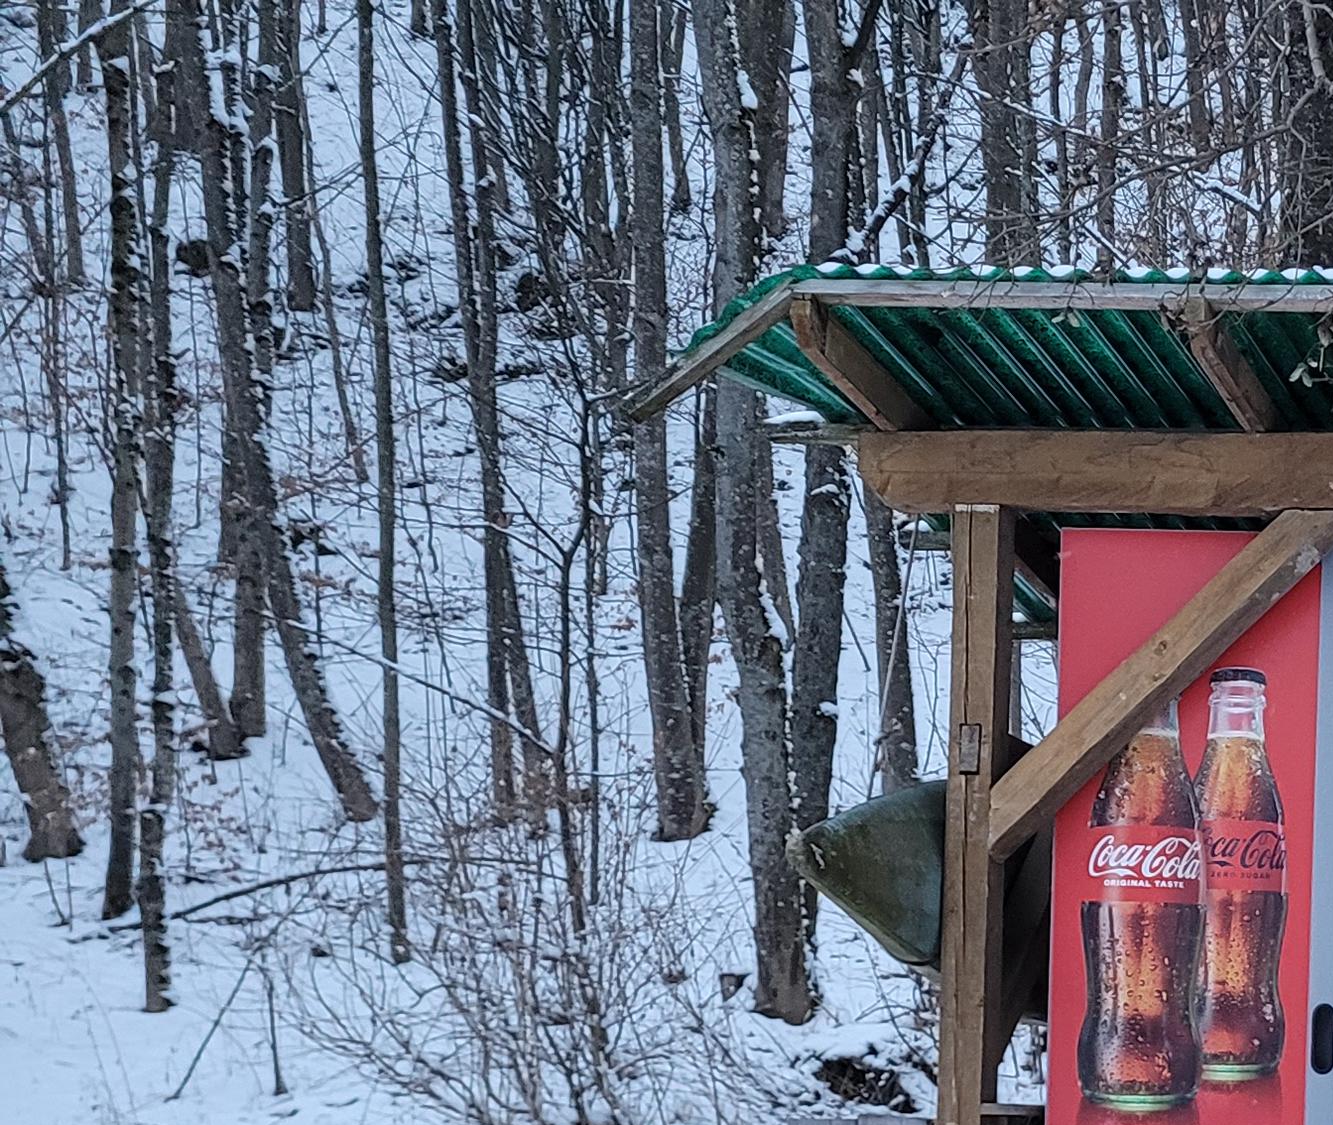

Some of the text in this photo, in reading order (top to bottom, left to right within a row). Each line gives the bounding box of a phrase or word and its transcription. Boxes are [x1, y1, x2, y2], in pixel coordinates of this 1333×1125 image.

[1088, 834, 1201, 880] Coca-Cola
[1103, 879, 1185, 889] ORIGINAL TASTE
